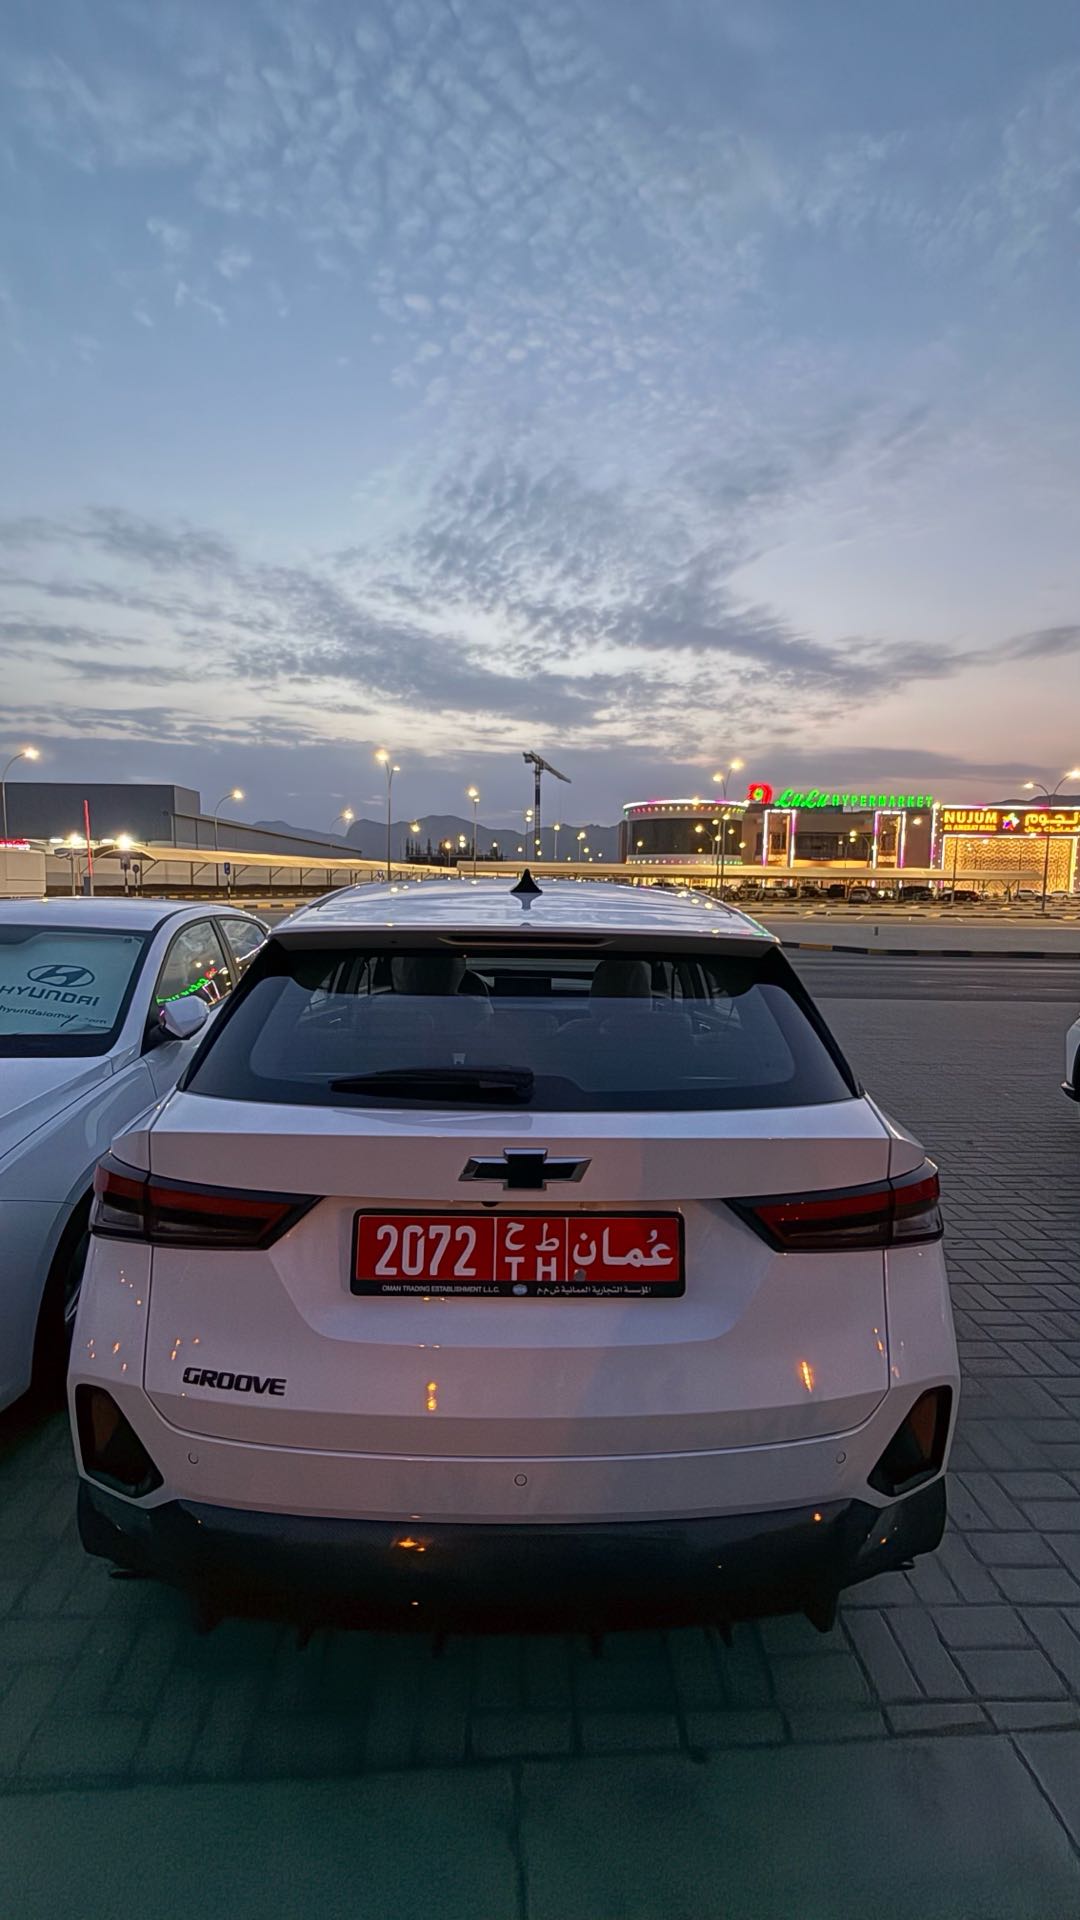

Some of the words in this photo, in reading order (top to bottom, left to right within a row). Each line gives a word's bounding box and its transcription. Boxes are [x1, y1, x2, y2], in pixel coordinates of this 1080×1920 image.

[832, 794, 933, 808] HYPERMARKET
[943, 811, 998, 824] NUJUM
[0, 985, 100, 1007] HYUNDAI
[374, 1224, 477, 1277] 2072
[402, 1285, 430, 1293] TRADING
[431, 1285, 482, 1293] ESTABLISHMENT
[182, 1367, 287, 1396] GROOVE
